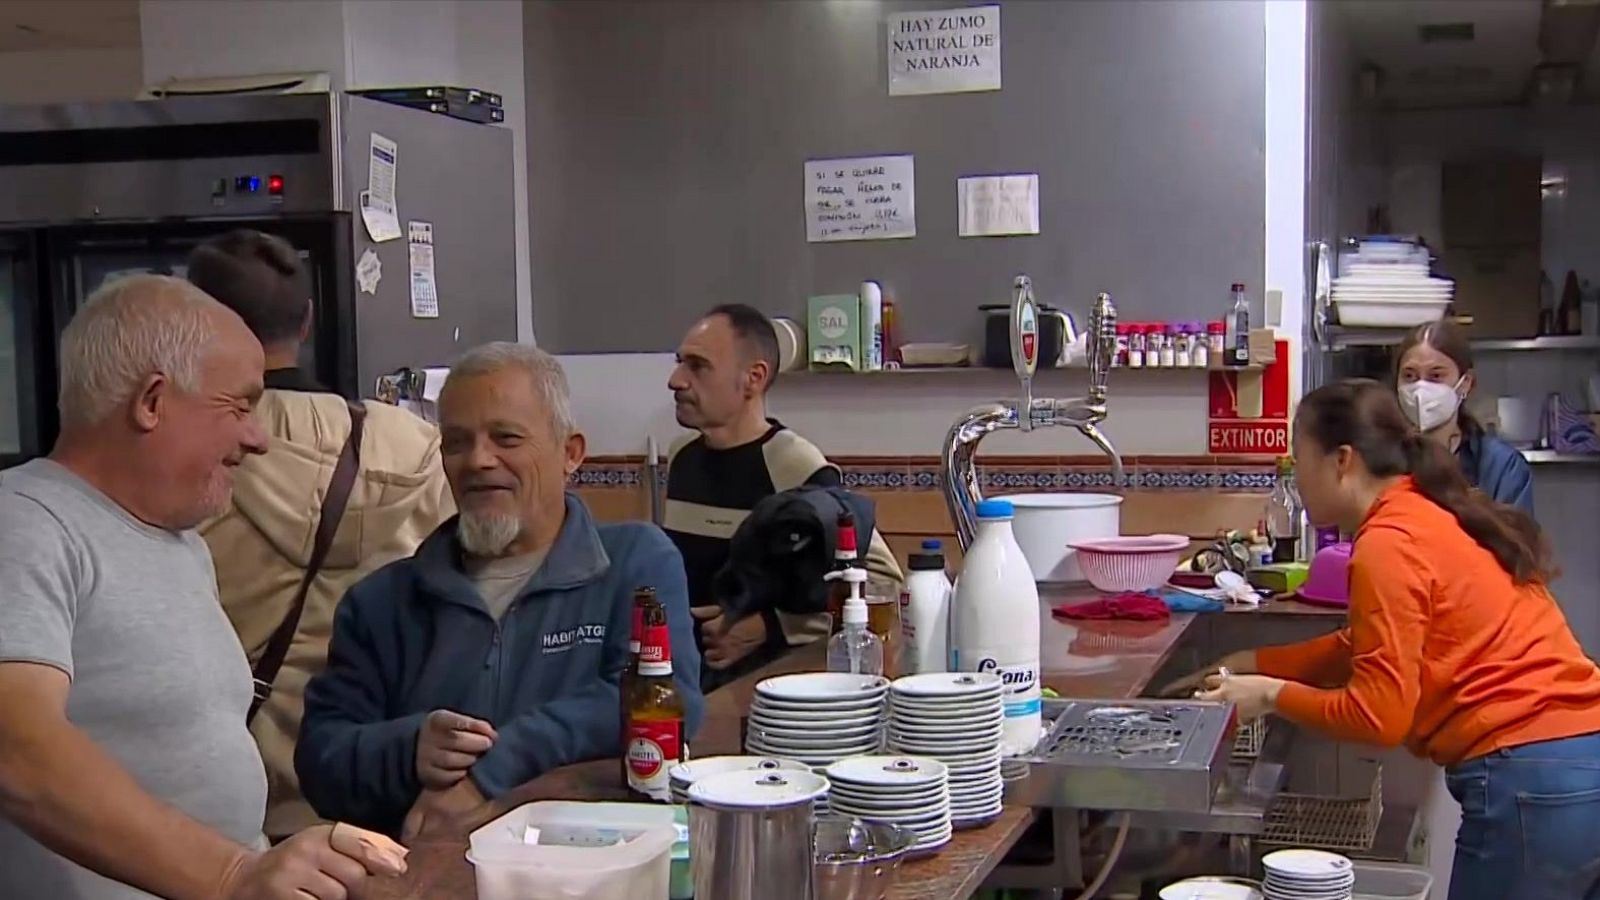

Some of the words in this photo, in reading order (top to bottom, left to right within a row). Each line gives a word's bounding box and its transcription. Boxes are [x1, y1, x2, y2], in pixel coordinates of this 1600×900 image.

[901, 18, 933, 33] HAY
[938, 15, 985, 31] ZUMO
[893, 35, 968, 53] NATURAL
[973, 34, 994, 47] DE
[906, 54, 980, 71] NARANJA
[819, 315, 846, 329] SAL
[1210, 428, 1286, 448] EXTINTOR
